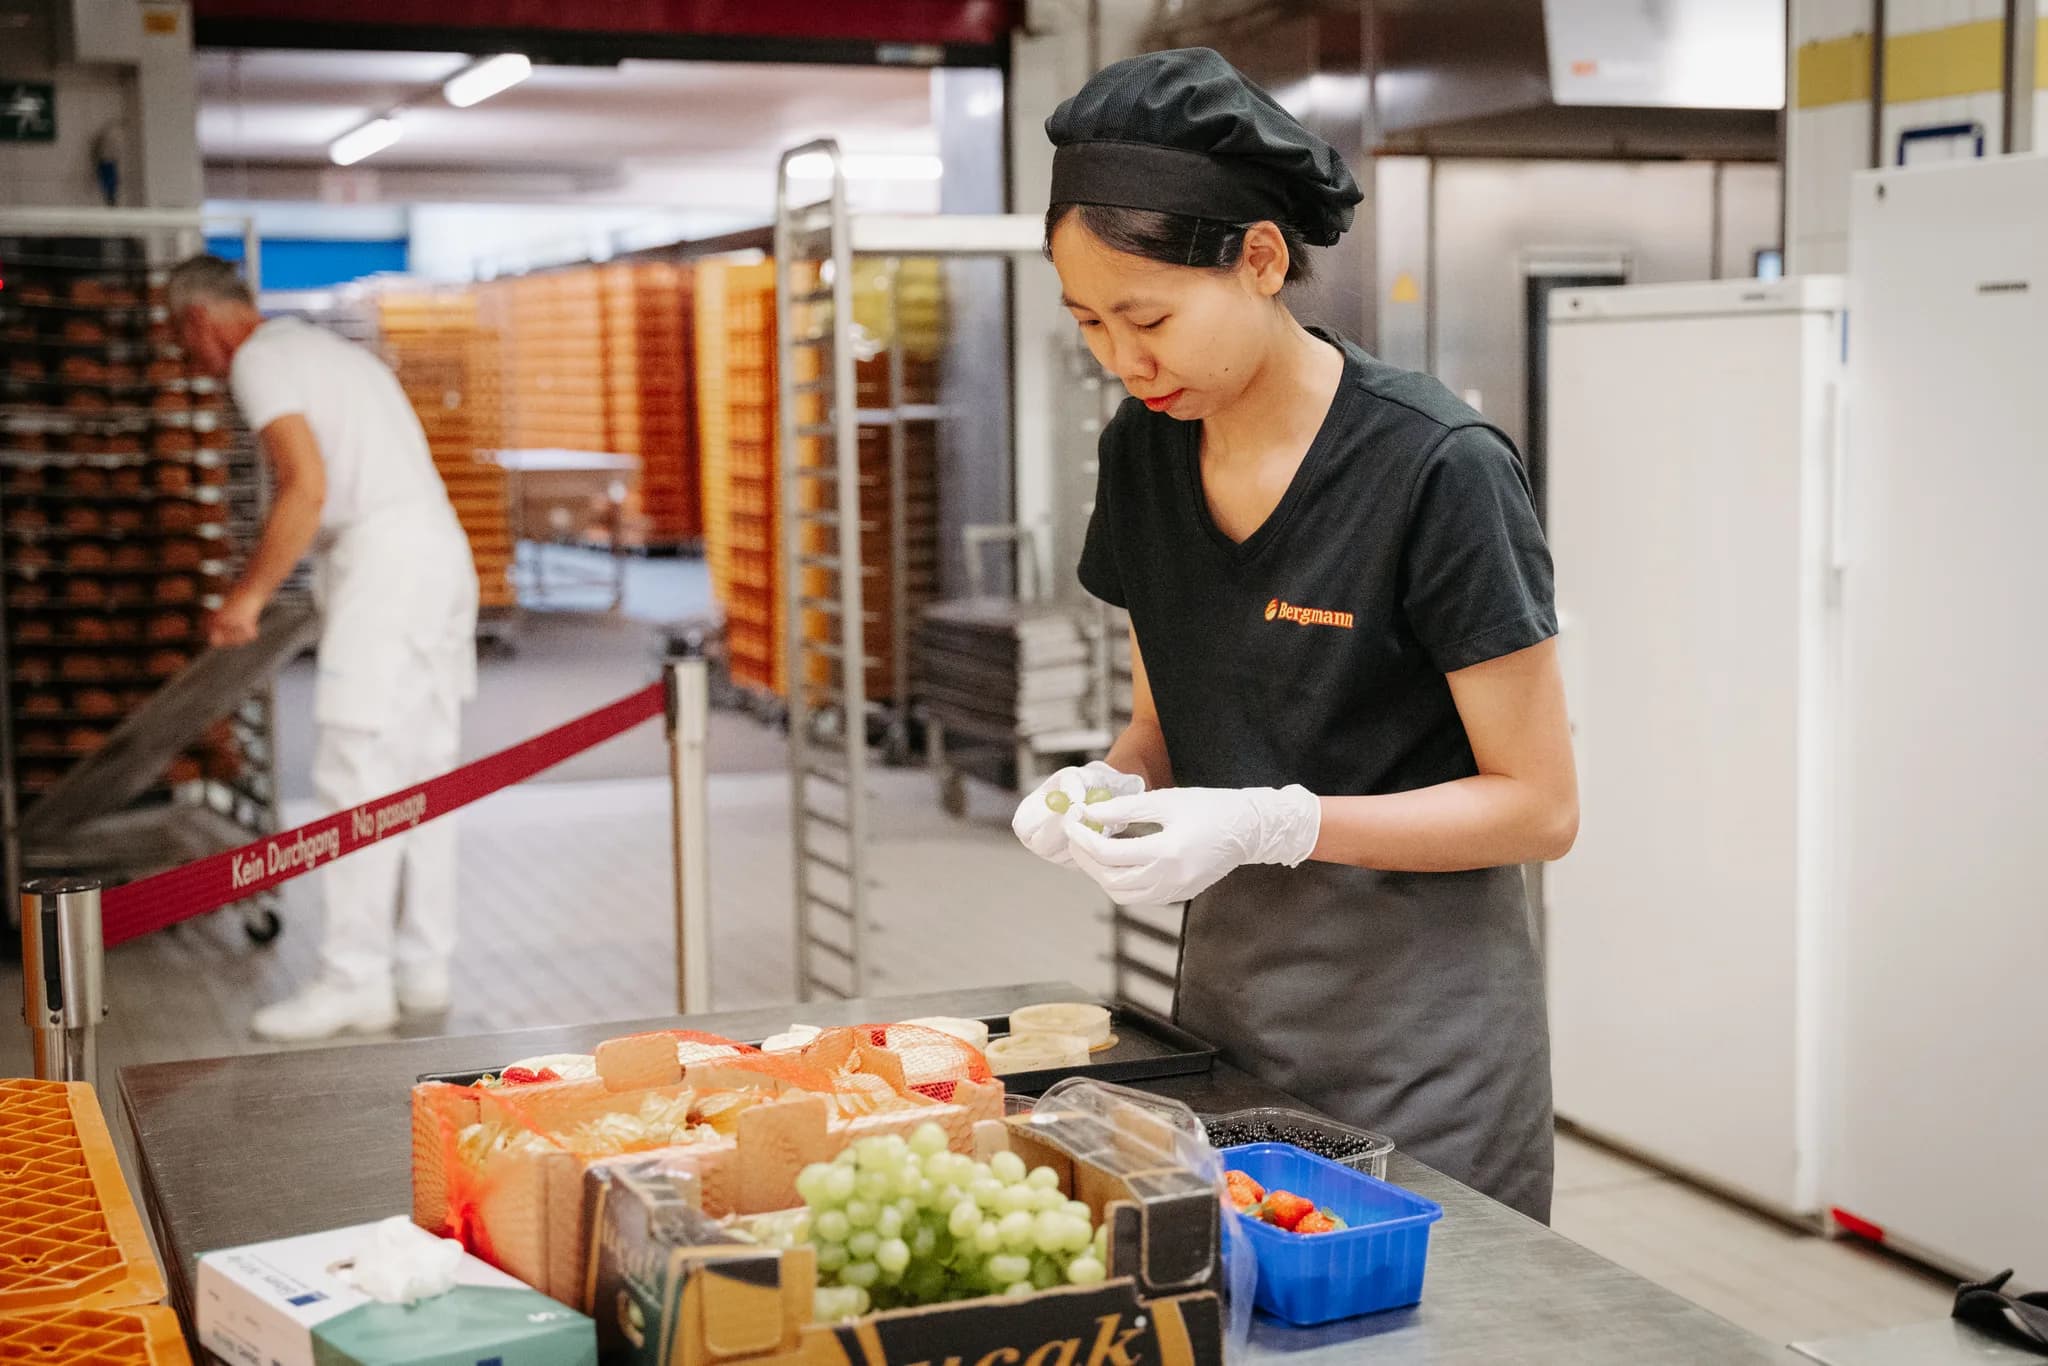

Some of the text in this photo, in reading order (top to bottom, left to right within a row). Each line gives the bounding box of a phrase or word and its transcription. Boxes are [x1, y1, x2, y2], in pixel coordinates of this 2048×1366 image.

[1278, 601, 1354, 628] Bergmann
[232, 792, 427, 889] Kein Durchgang No passage
[901, 1313, 1144, 1366] cak
